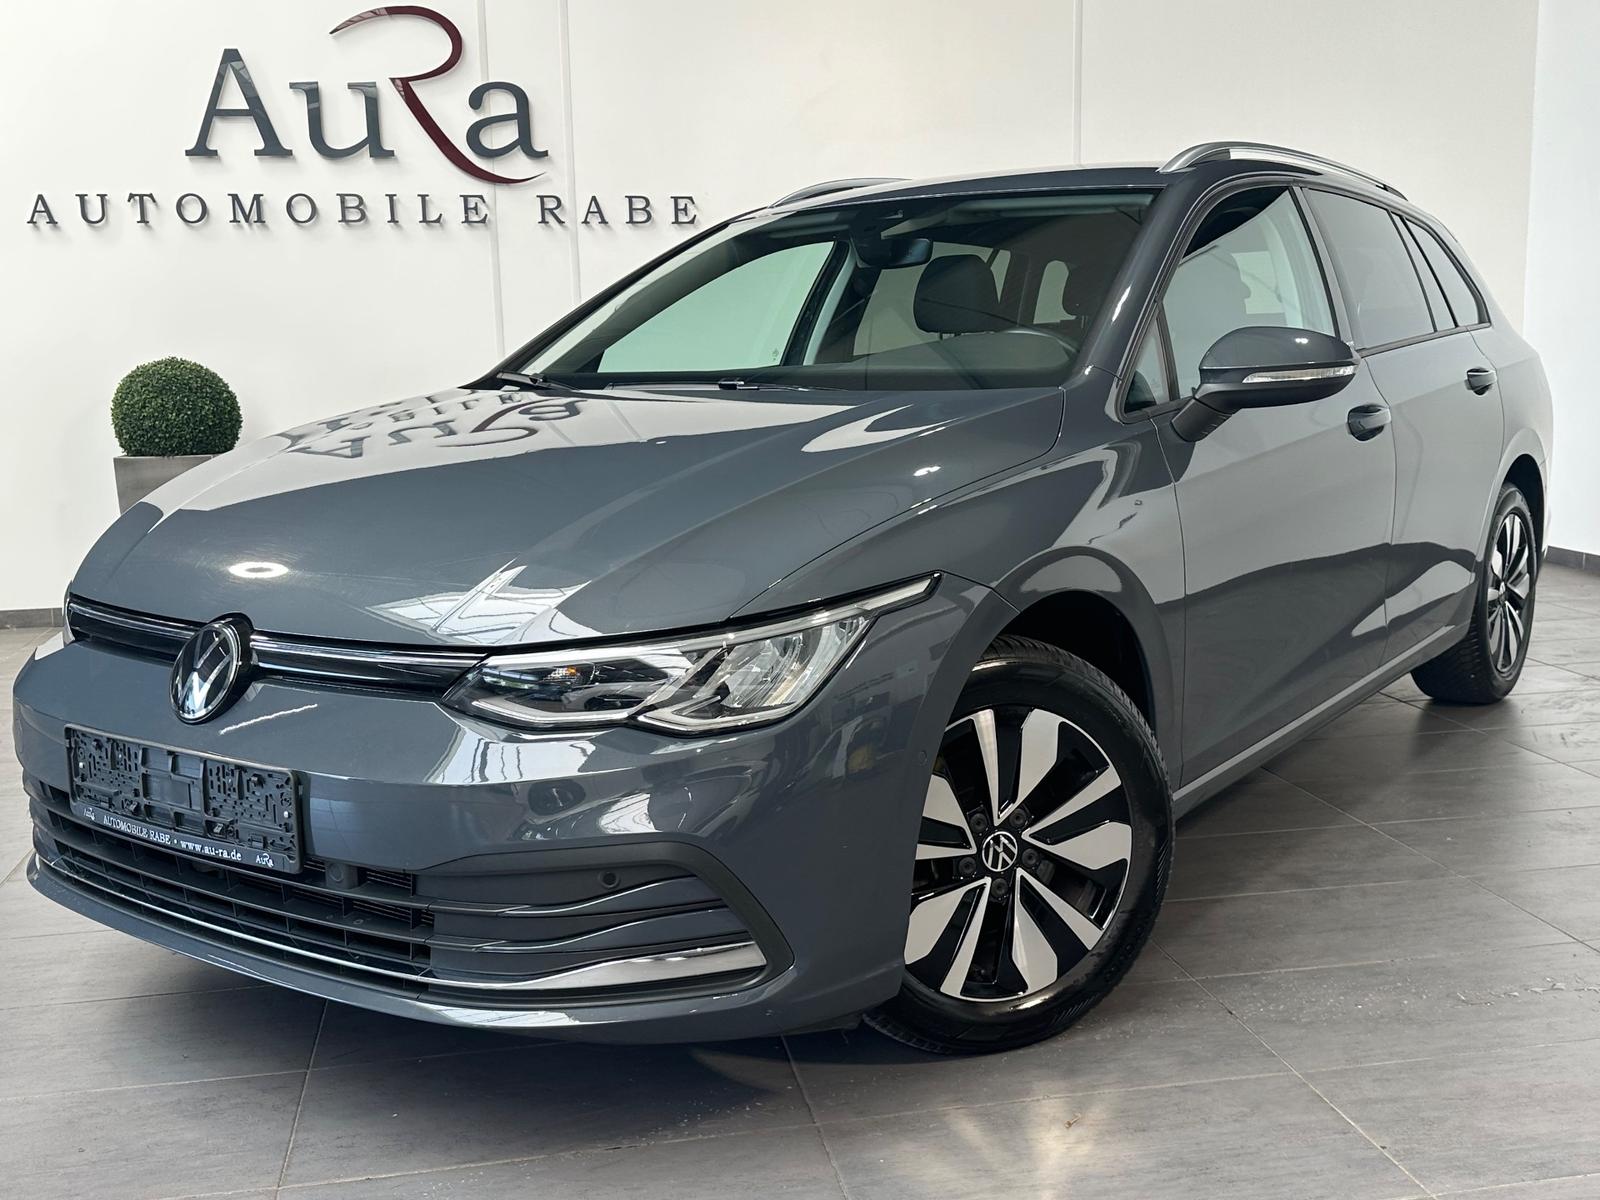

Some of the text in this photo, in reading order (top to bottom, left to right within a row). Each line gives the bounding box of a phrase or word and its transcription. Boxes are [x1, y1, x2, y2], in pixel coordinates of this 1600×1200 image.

[184, 5, 549, 187] AuRa
[26, 192, 698, 227] AUTOMOBILE RABE
[103, 815, 242, 861] AUTOMOBILE RABE www.au-ra.de
